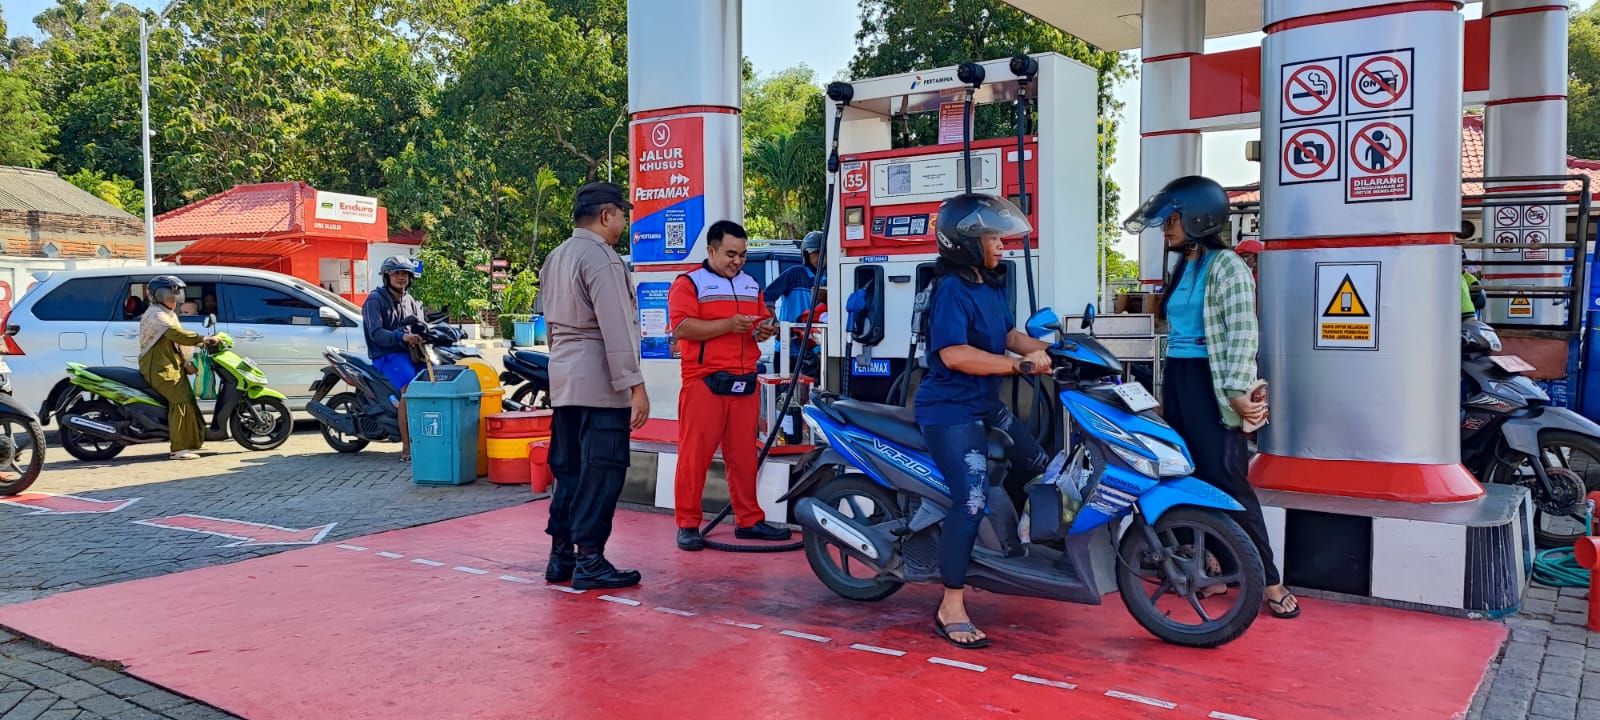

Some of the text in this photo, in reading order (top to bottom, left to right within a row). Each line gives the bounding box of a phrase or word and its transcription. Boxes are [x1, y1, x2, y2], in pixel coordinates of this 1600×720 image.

[924, 77, 953, 86] PERTAMINA
[1362, 80, 1377, 88] ON
[639, 147, 683, 162] JALUR
[639, 160, 684, 172] KHUSUS
[1353, 176, 1405, 187] DILARANG
[635, 187, 690, 201] PERTAMAX
[339, 202, 374, 213] Enduro
[873, 438, 931, 476] VARIO
[1106, 474, 1141, 491] HONDA
